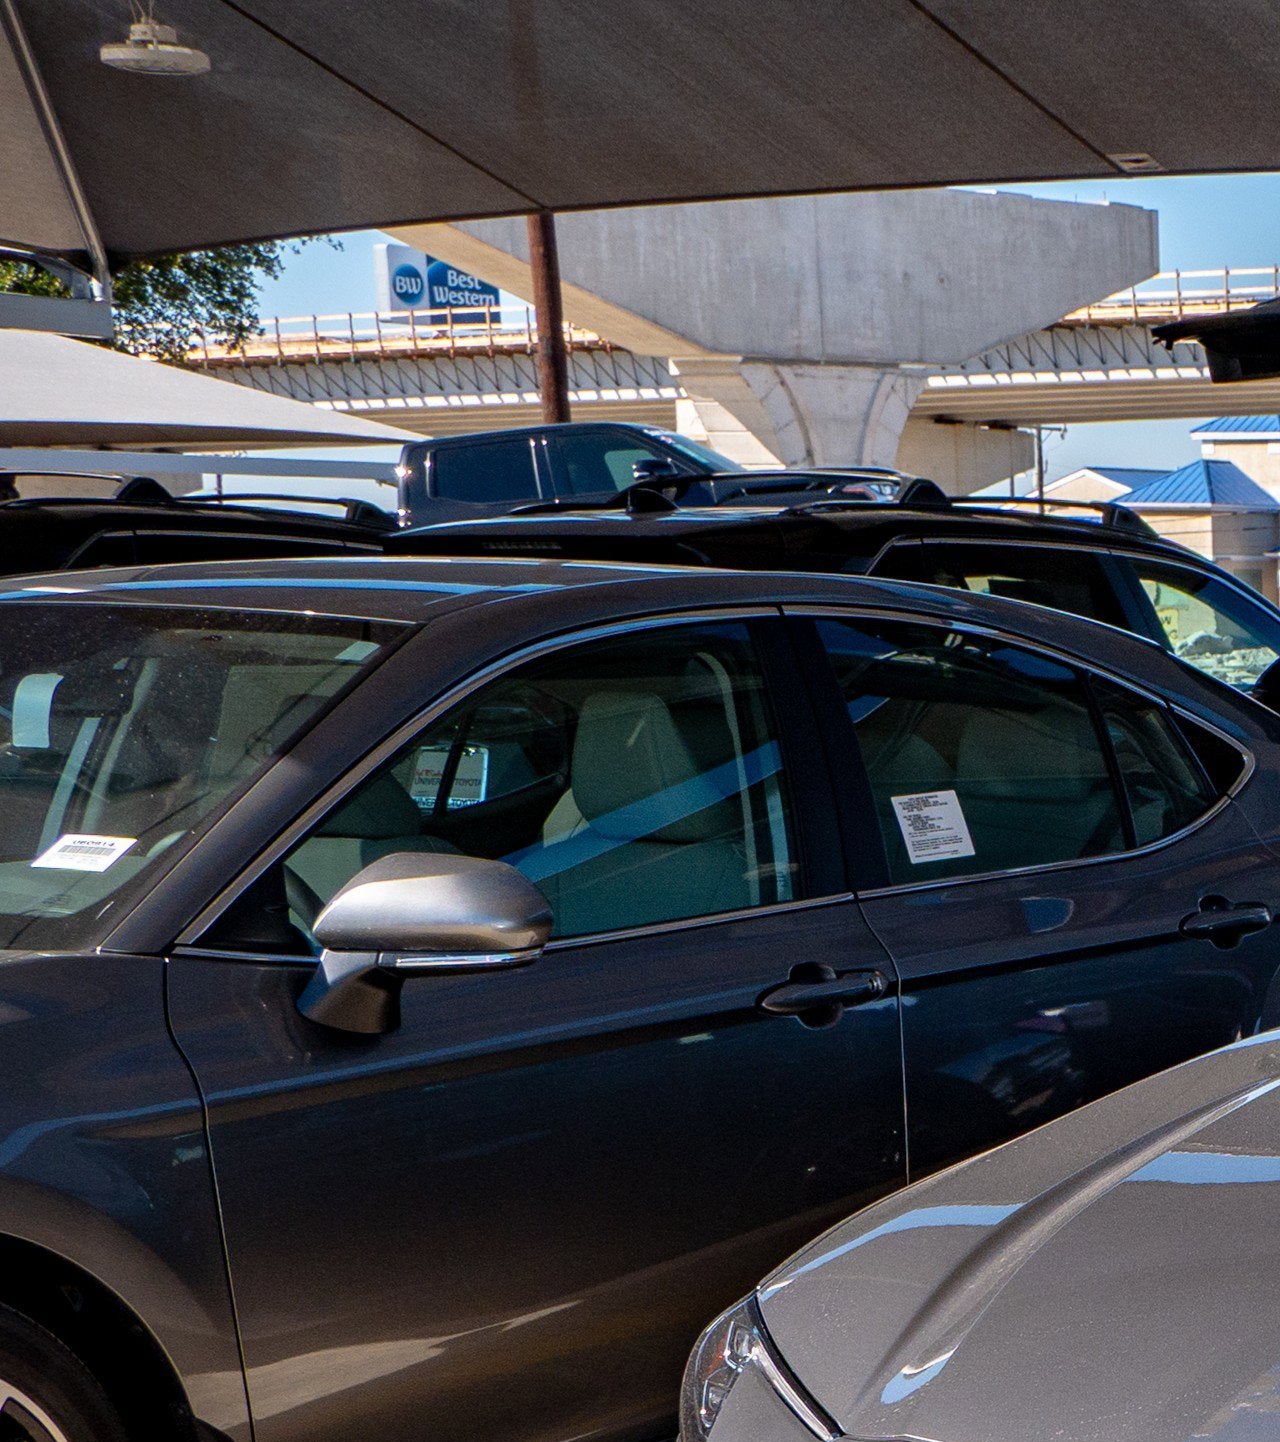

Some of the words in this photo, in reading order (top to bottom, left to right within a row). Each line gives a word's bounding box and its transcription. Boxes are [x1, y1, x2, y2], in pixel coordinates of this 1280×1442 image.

[395, 276, 421, 294] BW
[447, 270, 481, 290] Best
[433, 285, 496, 306] Western
